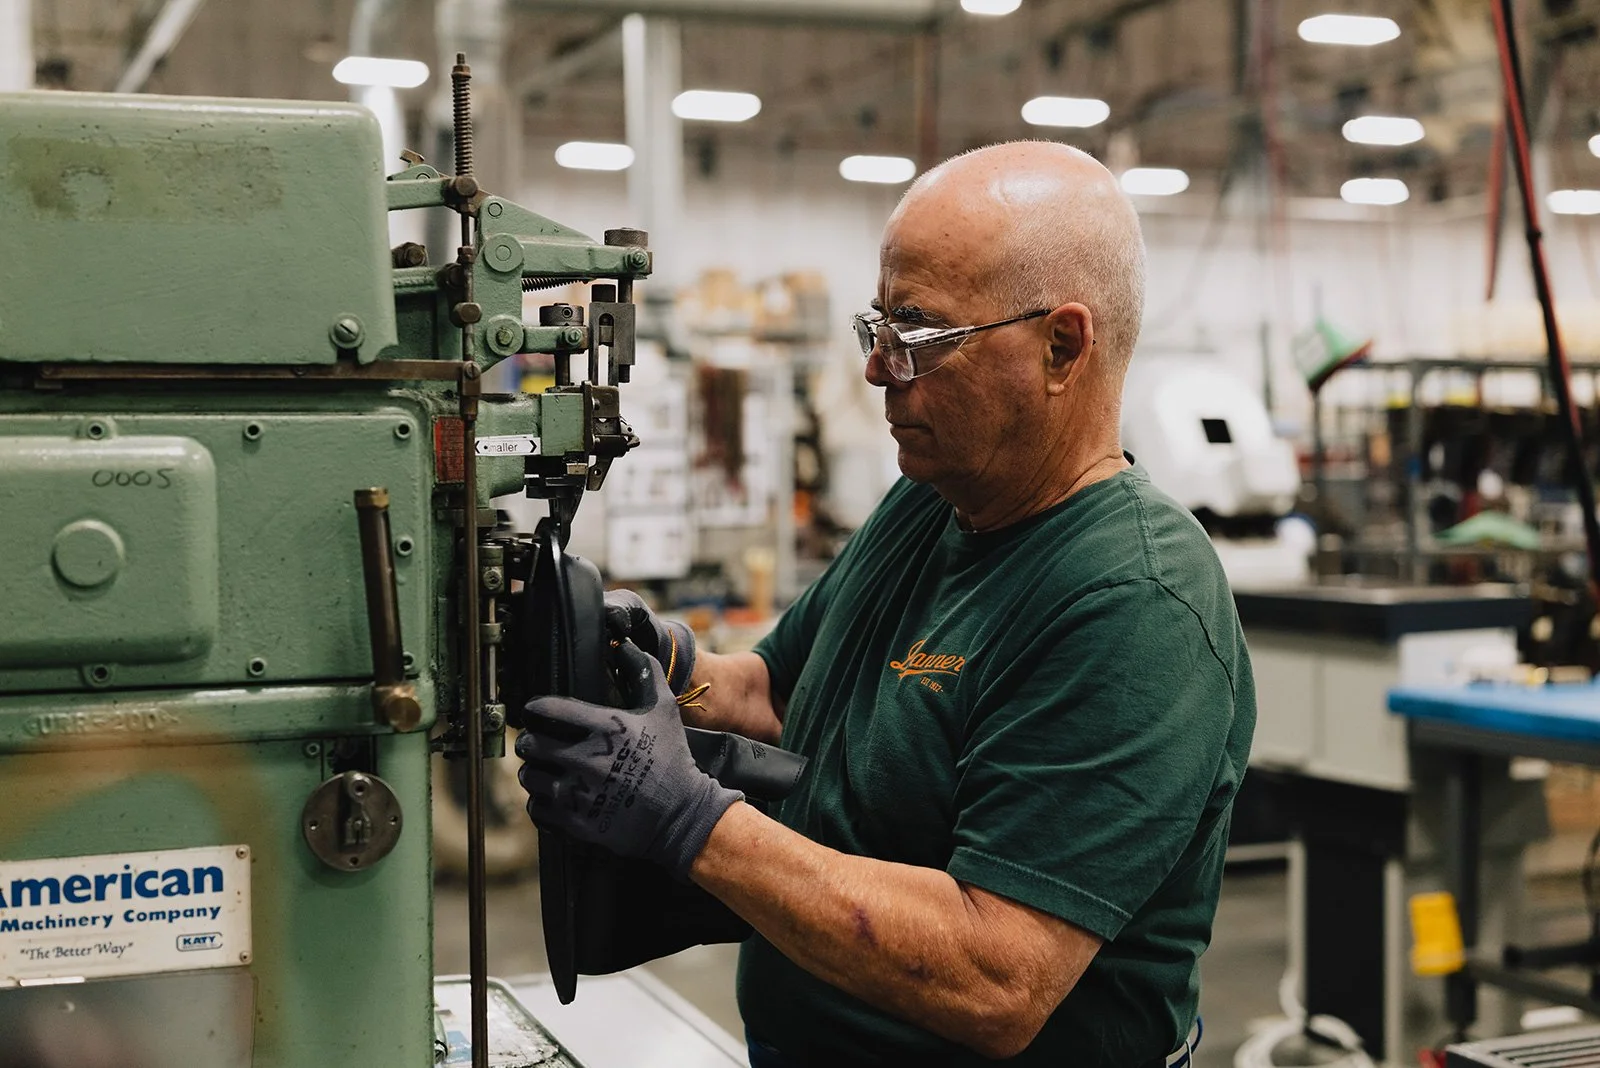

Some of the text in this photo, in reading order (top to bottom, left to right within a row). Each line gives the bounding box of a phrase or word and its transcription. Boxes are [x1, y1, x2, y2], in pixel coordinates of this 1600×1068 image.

[487, 443, 518, 453] maller
[0, 905, 221, 932] Machinery Company
[183, 936, 216, 945] KATY
[52, 946, 92, 958] Better
